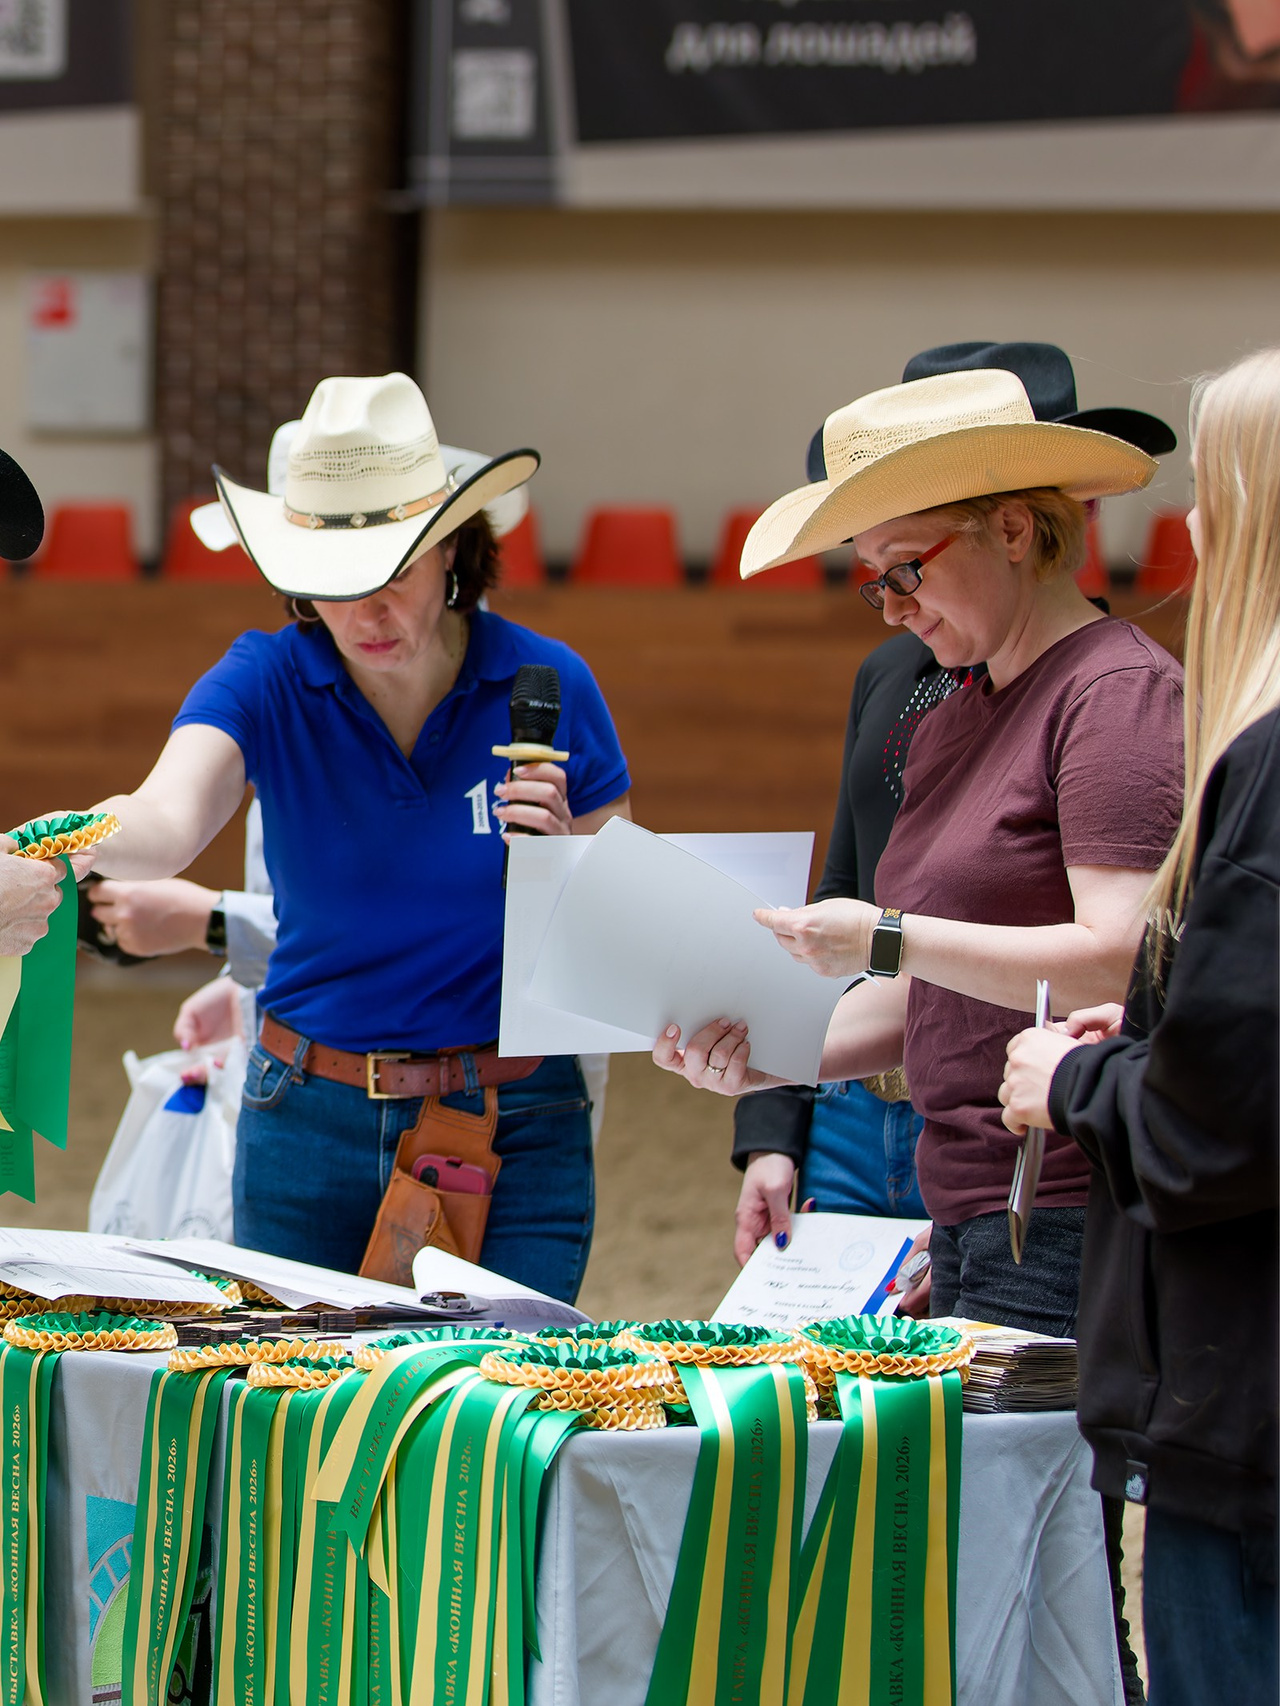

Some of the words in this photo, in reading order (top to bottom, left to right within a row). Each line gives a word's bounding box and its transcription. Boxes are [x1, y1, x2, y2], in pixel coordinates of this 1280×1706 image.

[668, 23, 757, 72] для
[765, 14, 977, 70] лошадей
[12, 1404, 21, 1448] 2026»
[750, 1418, 764, 1464] 2026»
[11, 1452, 20, 1513] ВЕСНА
[167, 1438, 178, 1483] 2026»
[249, 1459, 258, 1505] 2026»
[349, 1421, 387, 1519] ВЫСТАВКА
[895, 1436, 911, 1483] 2026»
[163, 1487, 175, 1549] ВЕСНА
[454, 1489, 468, 1555] ВЕСНА
[746, 1471, 763, 1536] ВЕСНА
[893, 1488, 909, 1553] ВЕСНА
[10, 1517, 19, 1601] «КОННАЯ
[248, 1509, 257, 1573] ВЕСНА
[156, 1553, 171, 1640] «КОННАЯ
[321, 1546, 336, 1637] «КОННАЯ
[449, 1559, 463, 1654] «КОННАЯ
[737, 1543, 757, 1636] «КОННАЯ
[890, 1560, 906, 1652] «КОННАЯ
[245, 1577, 256, 1668] «КОННАЯ
[9, 1607, 19, 1705] ВЫСТАВКА
